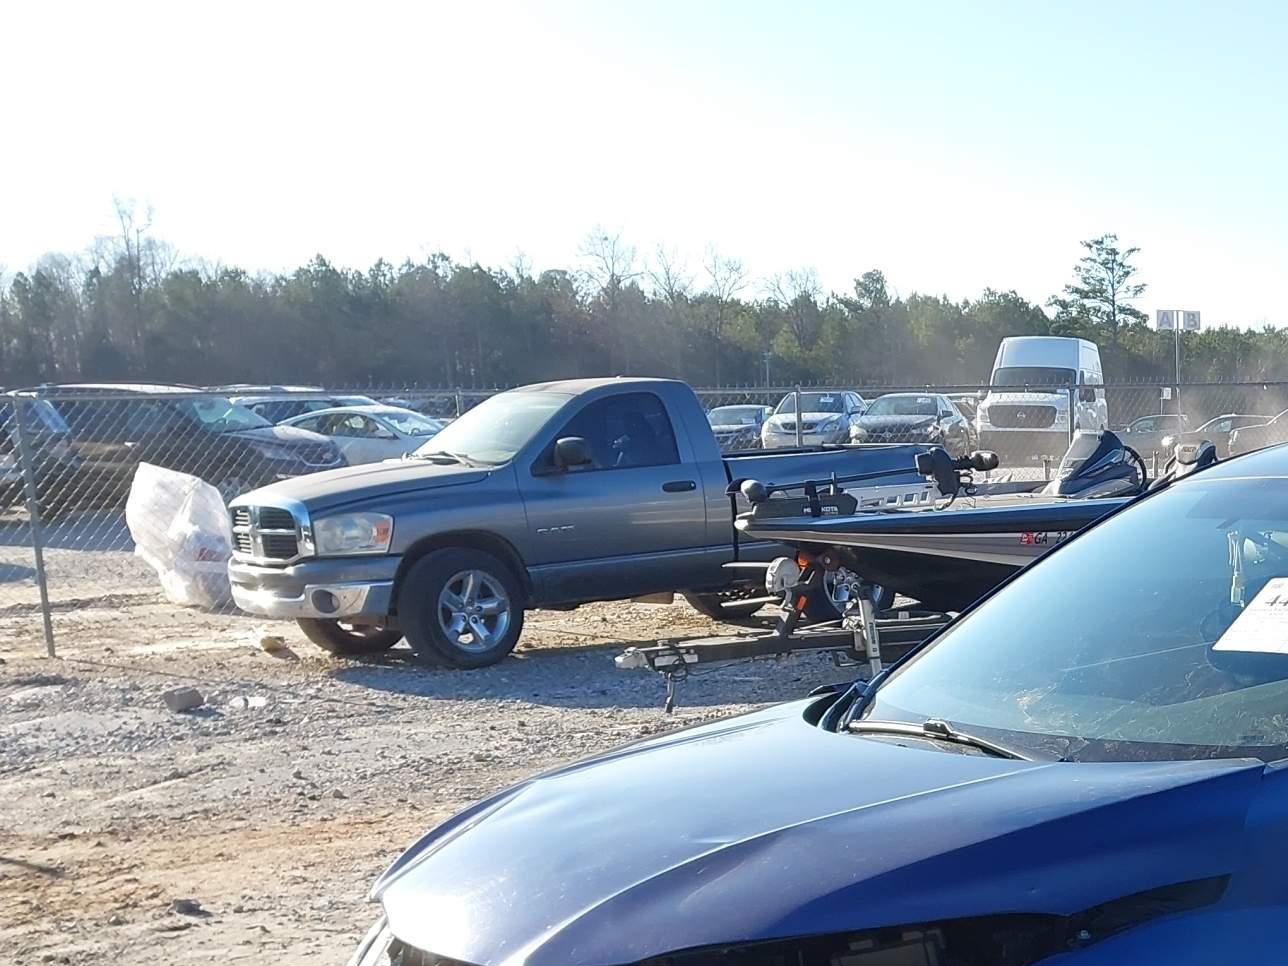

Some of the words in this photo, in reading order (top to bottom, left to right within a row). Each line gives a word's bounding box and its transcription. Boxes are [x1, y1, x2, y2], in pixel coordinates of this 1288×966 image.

[1160, 311, 1171, 328] A
[1187, 312, 1198, 328] B
[1034, 531, 1048, 545] GA
